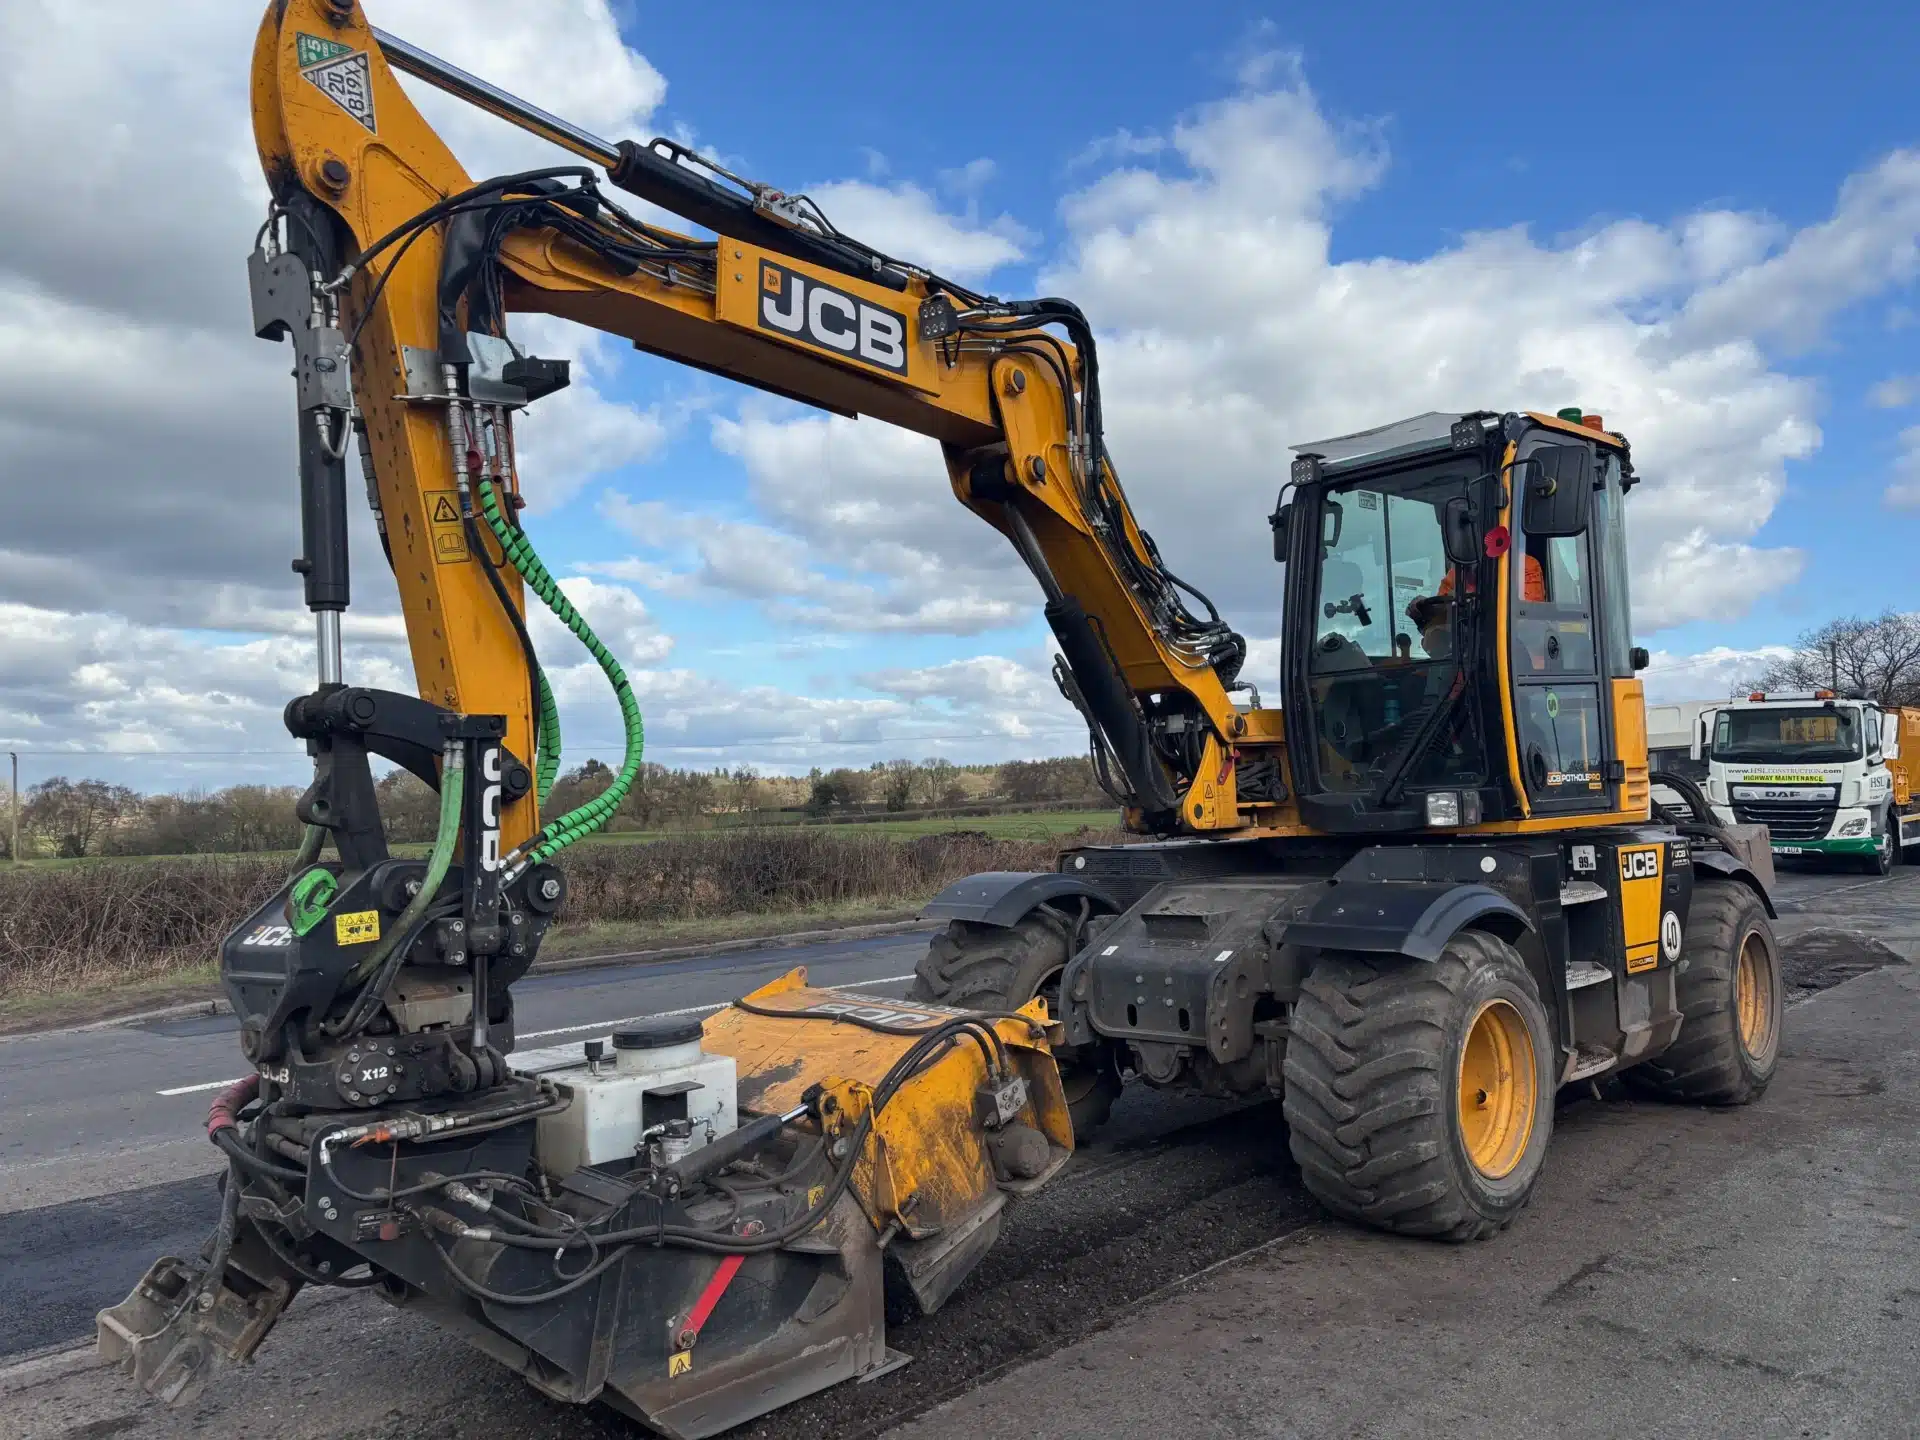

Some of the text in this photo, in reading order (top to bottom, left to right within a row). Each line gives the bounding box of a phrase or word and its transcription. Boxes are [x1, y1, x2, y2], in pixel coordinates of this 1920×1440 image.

[307, 39, 321, 52] 5
[763, 277, 904, 368] JCB
[1870, 776, 1885, 788] HSL
[1579, 856, 1589, 869] 99
[1622, 851, 1658, 879] JCB
[1666, 921, 1678, 951] 40
[361, 1066, 389, 1082] X12
